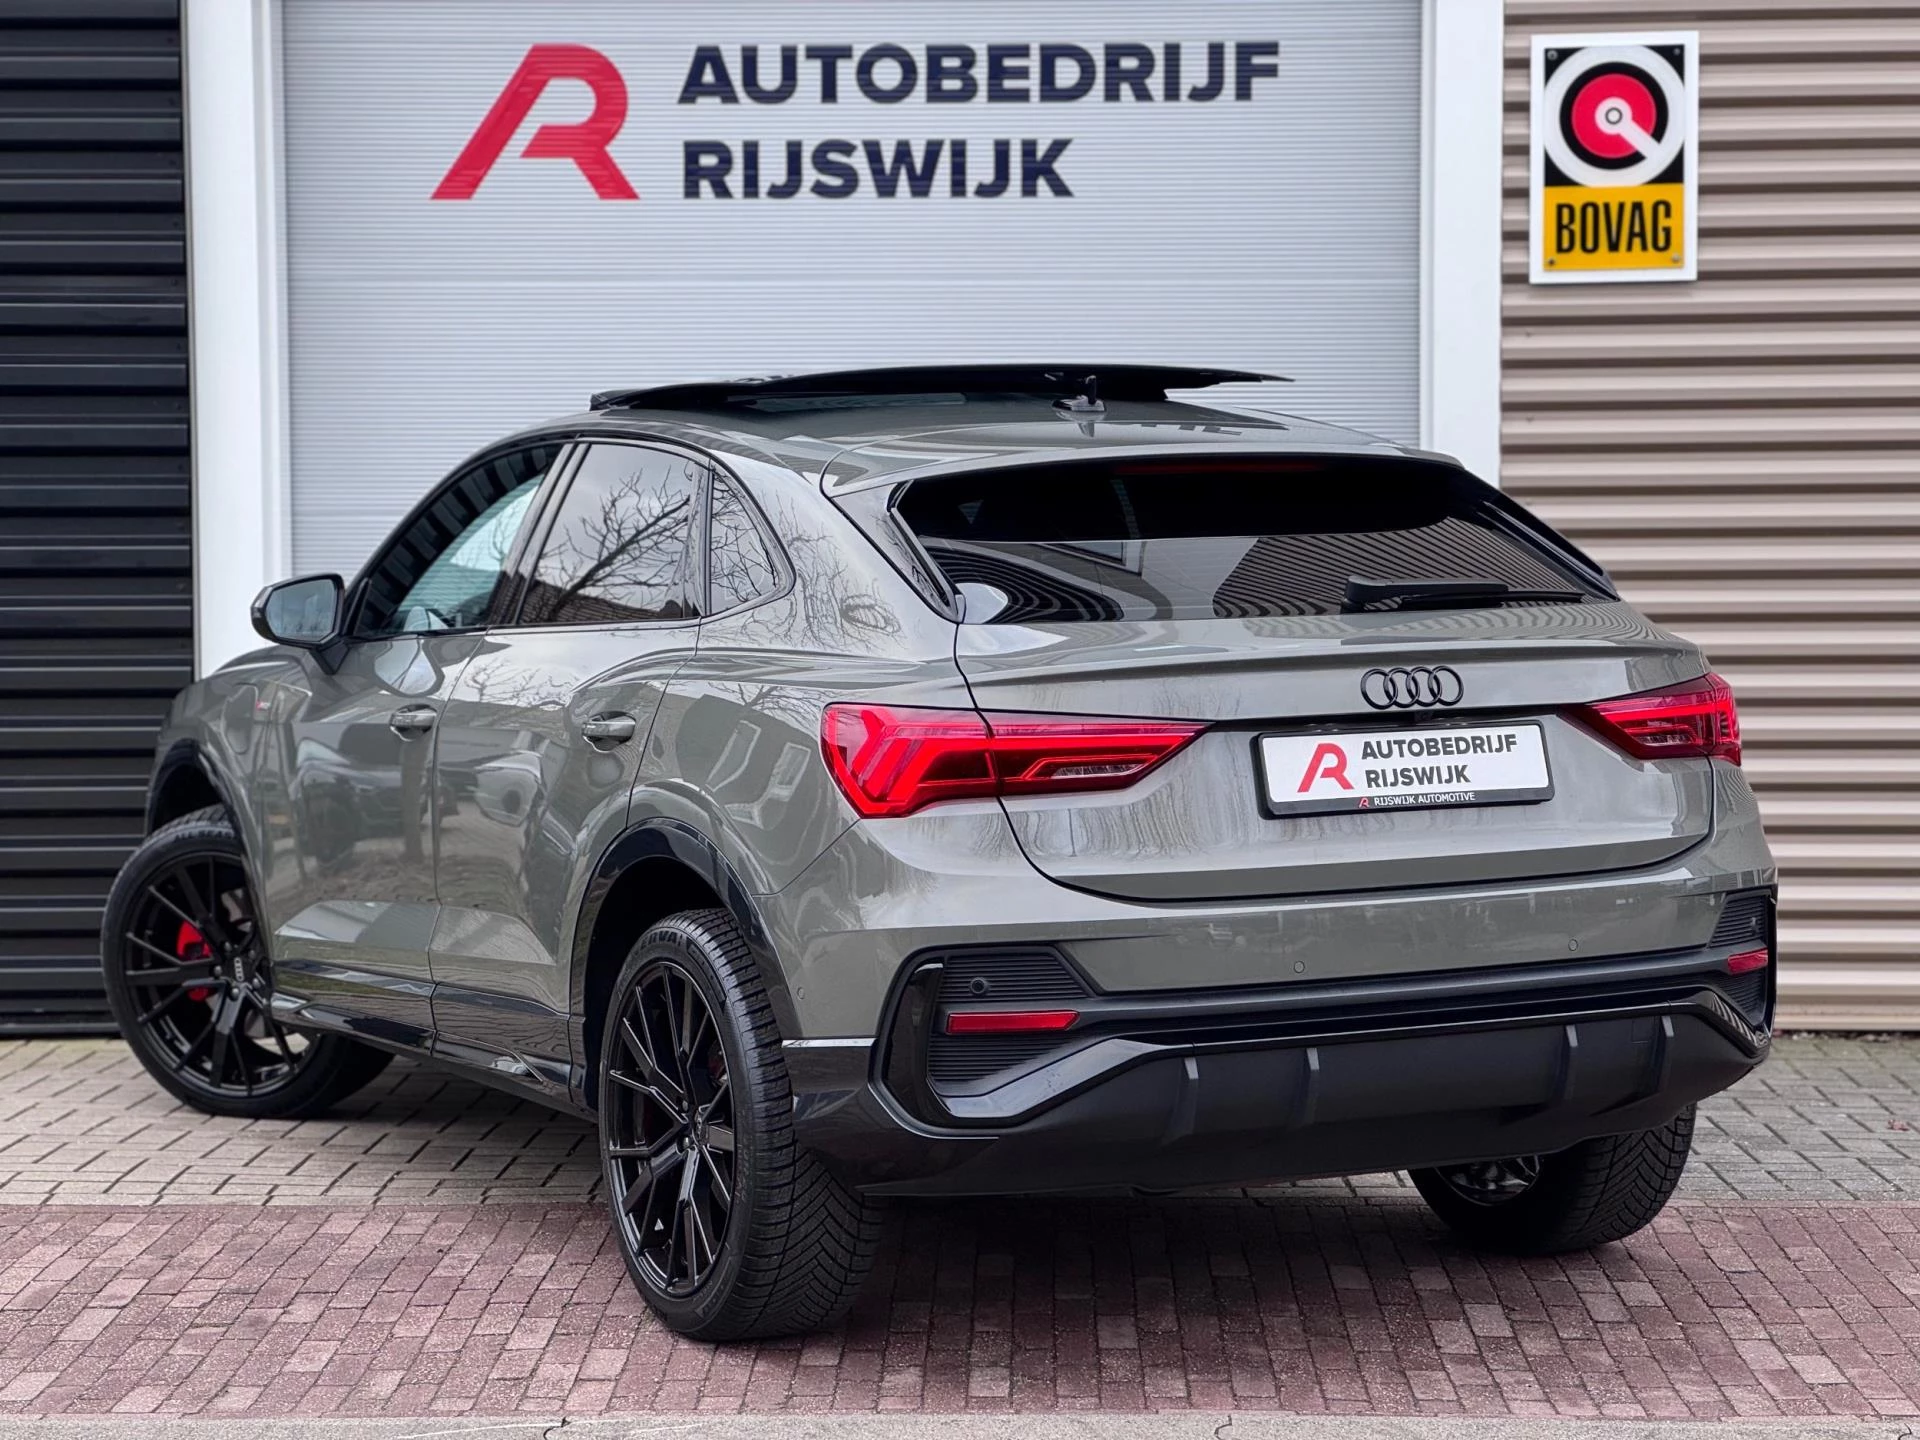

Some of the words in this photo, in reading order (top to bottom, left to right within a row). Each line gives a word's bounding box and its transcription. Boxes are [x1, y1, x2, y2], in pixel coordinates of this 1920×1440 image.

[677, 41, 1280, 104] AUTOBEDRIJF
[683, 138, 1075, 199] RIJSWIJK
[1555, 200, 1672, 254] BOVAG
[1361, 734, 1517, 760] AUTOBEDRIJF
[1365, 764, 1471, 789] RIJSWIJK
[1374, 795, 1416, 806] RIJSWIJK
[1418, 792, 1476, 804] AUTOMOTIVE
